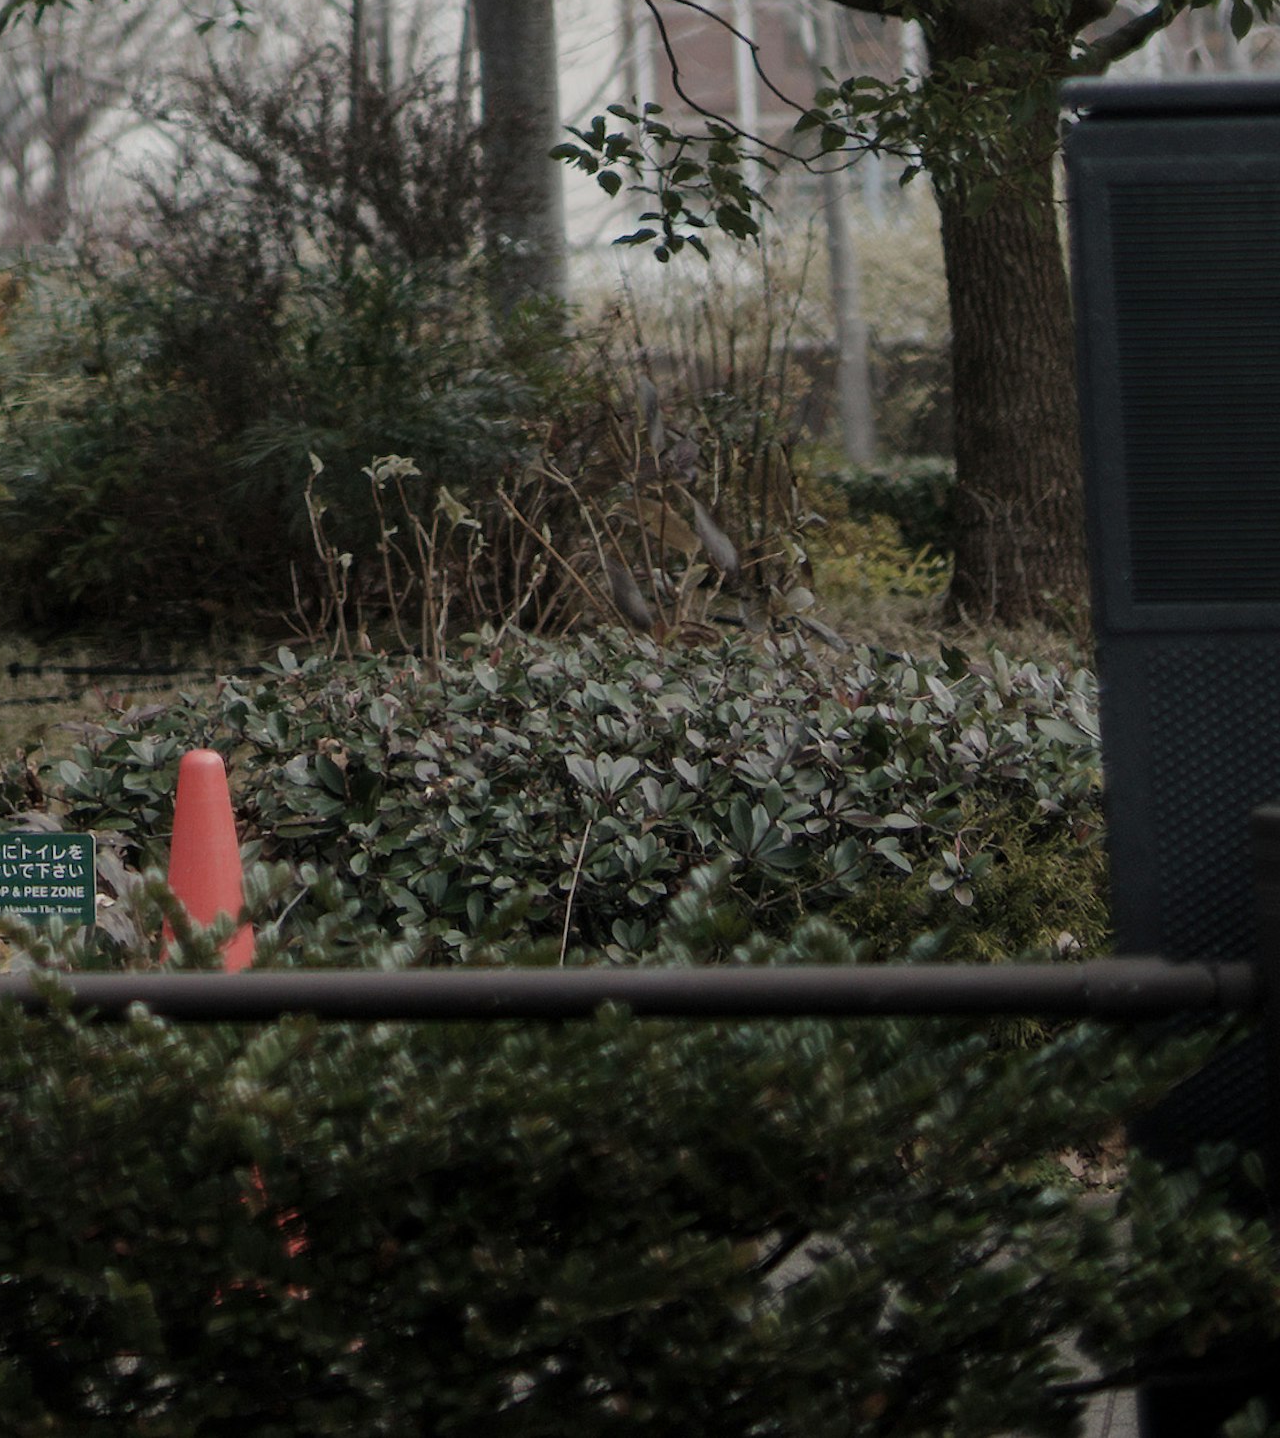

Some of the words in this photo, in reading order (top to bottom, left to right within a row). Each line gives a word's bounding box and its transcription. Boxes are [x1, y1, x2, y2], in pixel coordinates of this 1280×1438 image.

[12, 886, 21, 898] &
[24, 886, 48, 898] PEE
[51, 886, 85, 898] ZONE
[4, 905, 38, 914] Akasaka
[39, 905, 55, 914] The
[56, 905, 82, 914] Tower
